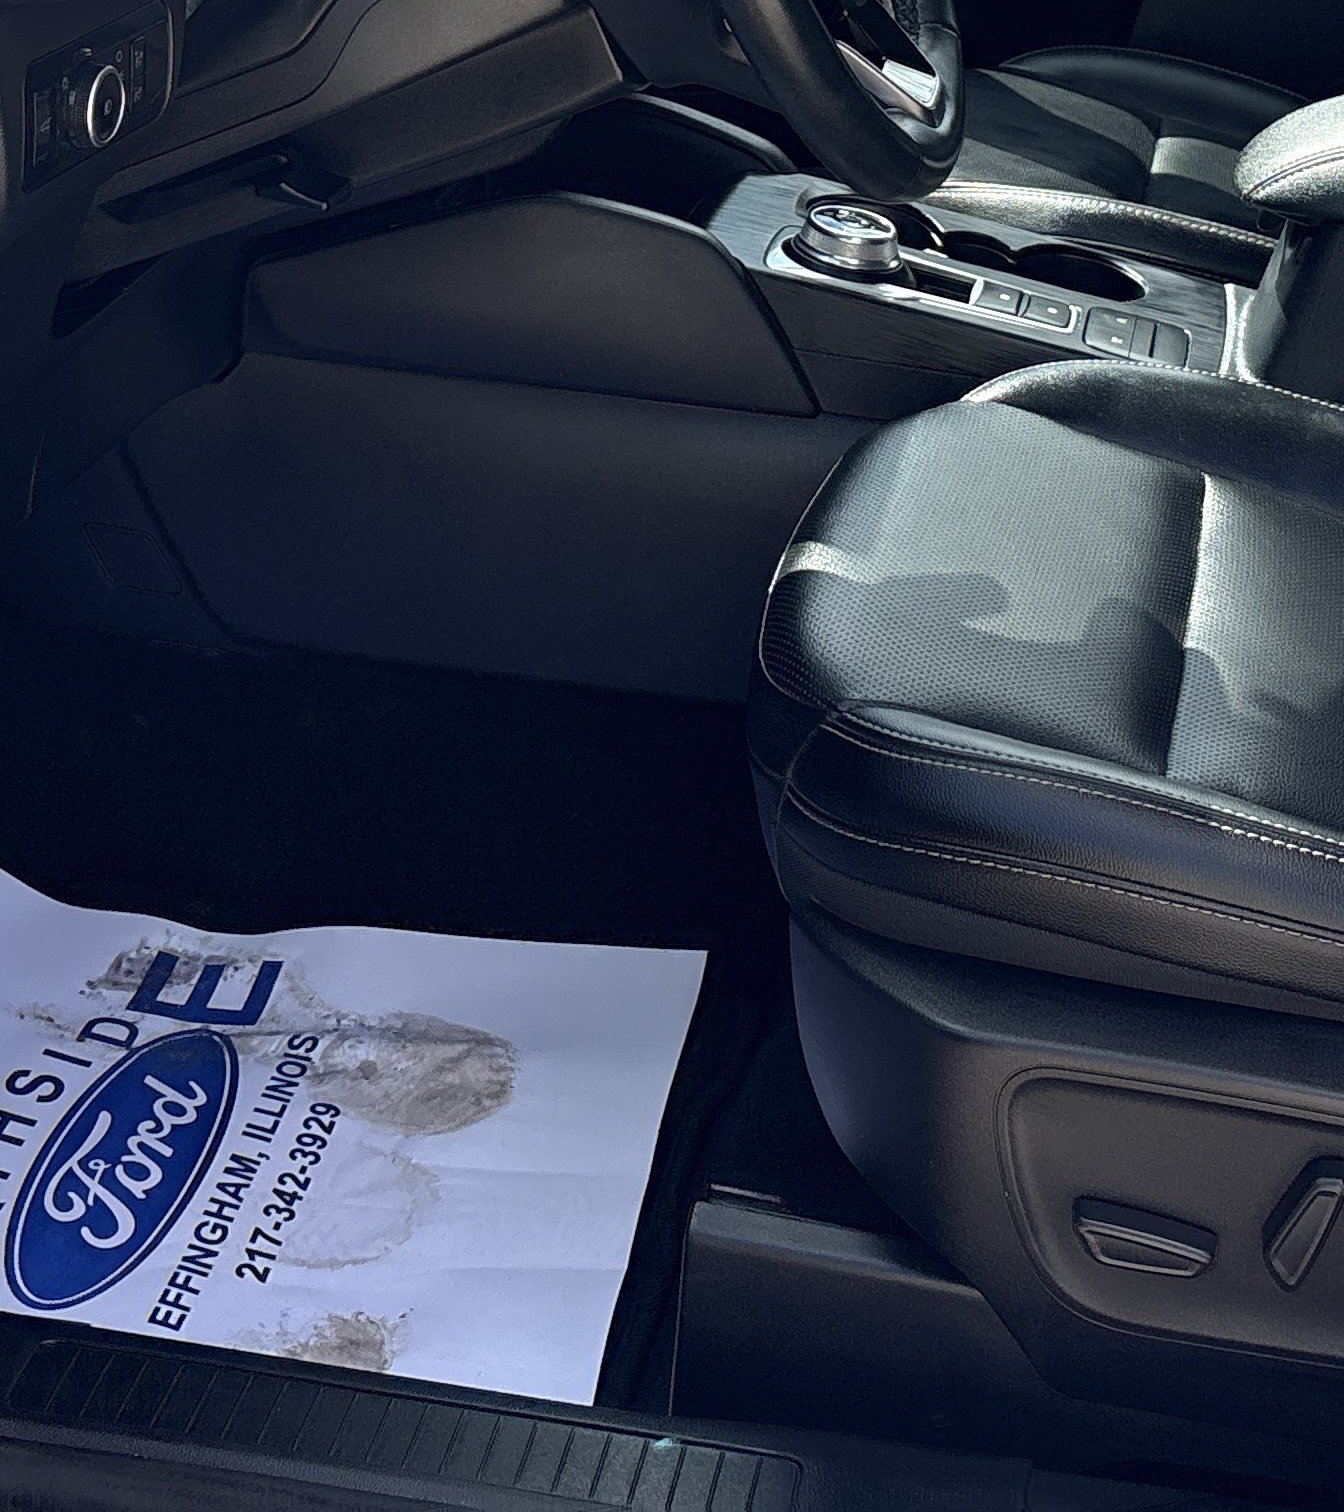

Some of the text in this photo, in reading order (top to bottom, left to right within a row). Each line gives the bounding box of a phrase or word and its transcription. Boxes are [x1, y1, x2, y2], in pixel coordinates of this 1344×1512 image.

[43, 1074, 208, 1249] Ford
[147, 1033, 319, 1332] EFFINGHAM, ILLINOIS
[234, 1101, 342, 1284] 217-342-3929
